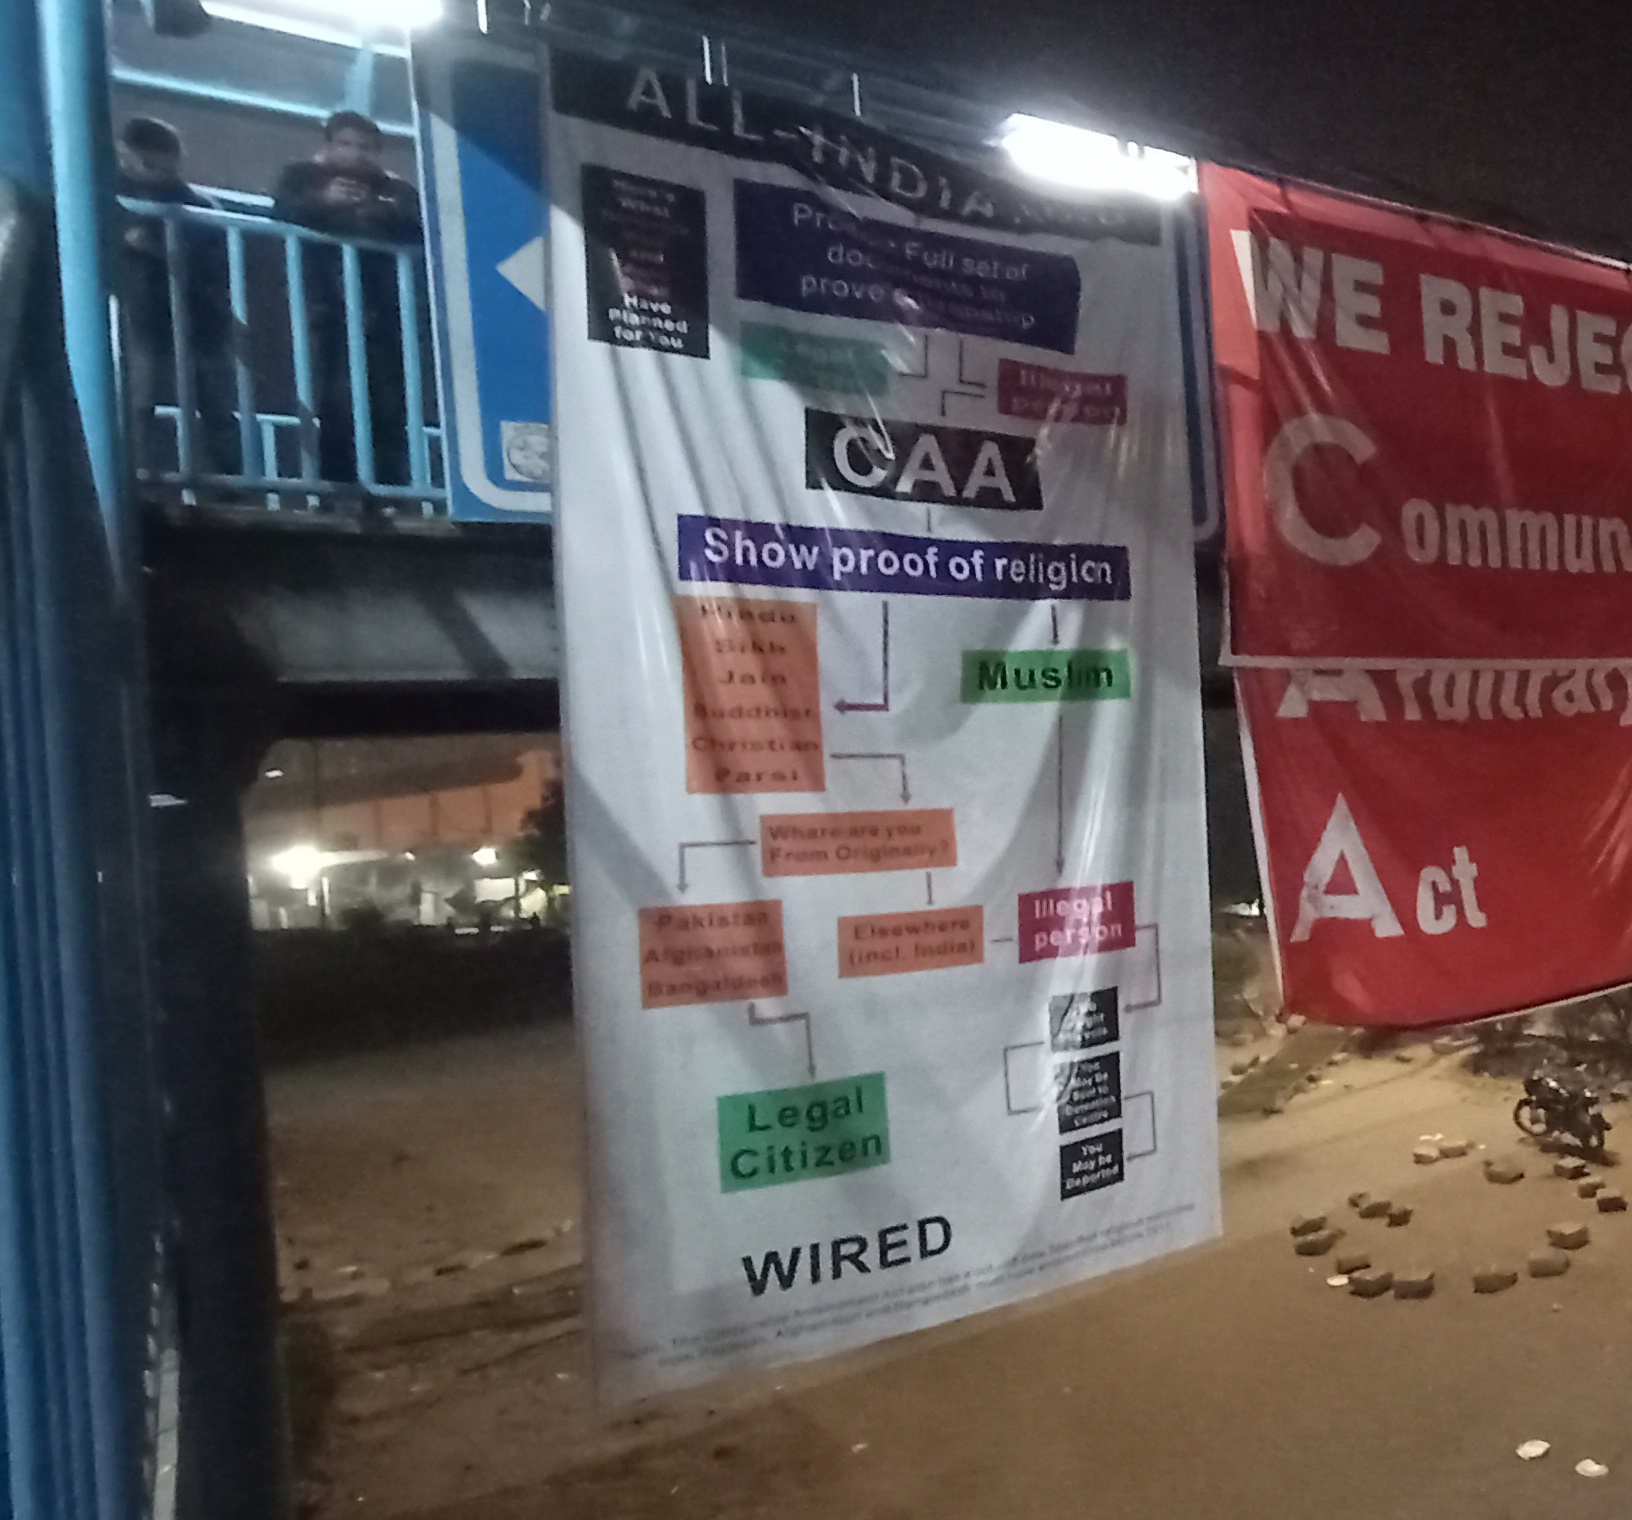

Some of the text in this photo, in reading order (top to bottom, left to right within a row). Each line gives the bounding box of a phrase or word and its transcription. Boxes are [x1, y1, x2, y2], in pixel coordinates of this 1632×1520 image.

[904, 241, 955, 270] Full
[1230, 230, 1390, 355] WE
[832, 422, 1015, 502] CAA
[703, 527, 1112, 591] Show proof of religion
[718, 670, 789, 685] Jain
[977, 657, 1113, 692] Muslim
[692, 736, 820, 753] Christian
[714, 765, 799, 784] Parsi
[769, 846, 828, 863] From
[1290, 792, 1488, 943] Act
[656, 912, 768, 934] Pakistan
[1034, 889, 1113, 923] Illegal
[853, 917, 970, 940] Elsewhere
[1033, 922, 1123, 950] person
[747, 1086, 864, 1134] Legal
[729, 1130, 883, 1179] Citizen
[741, 1214, 953, 1297] WIRED
